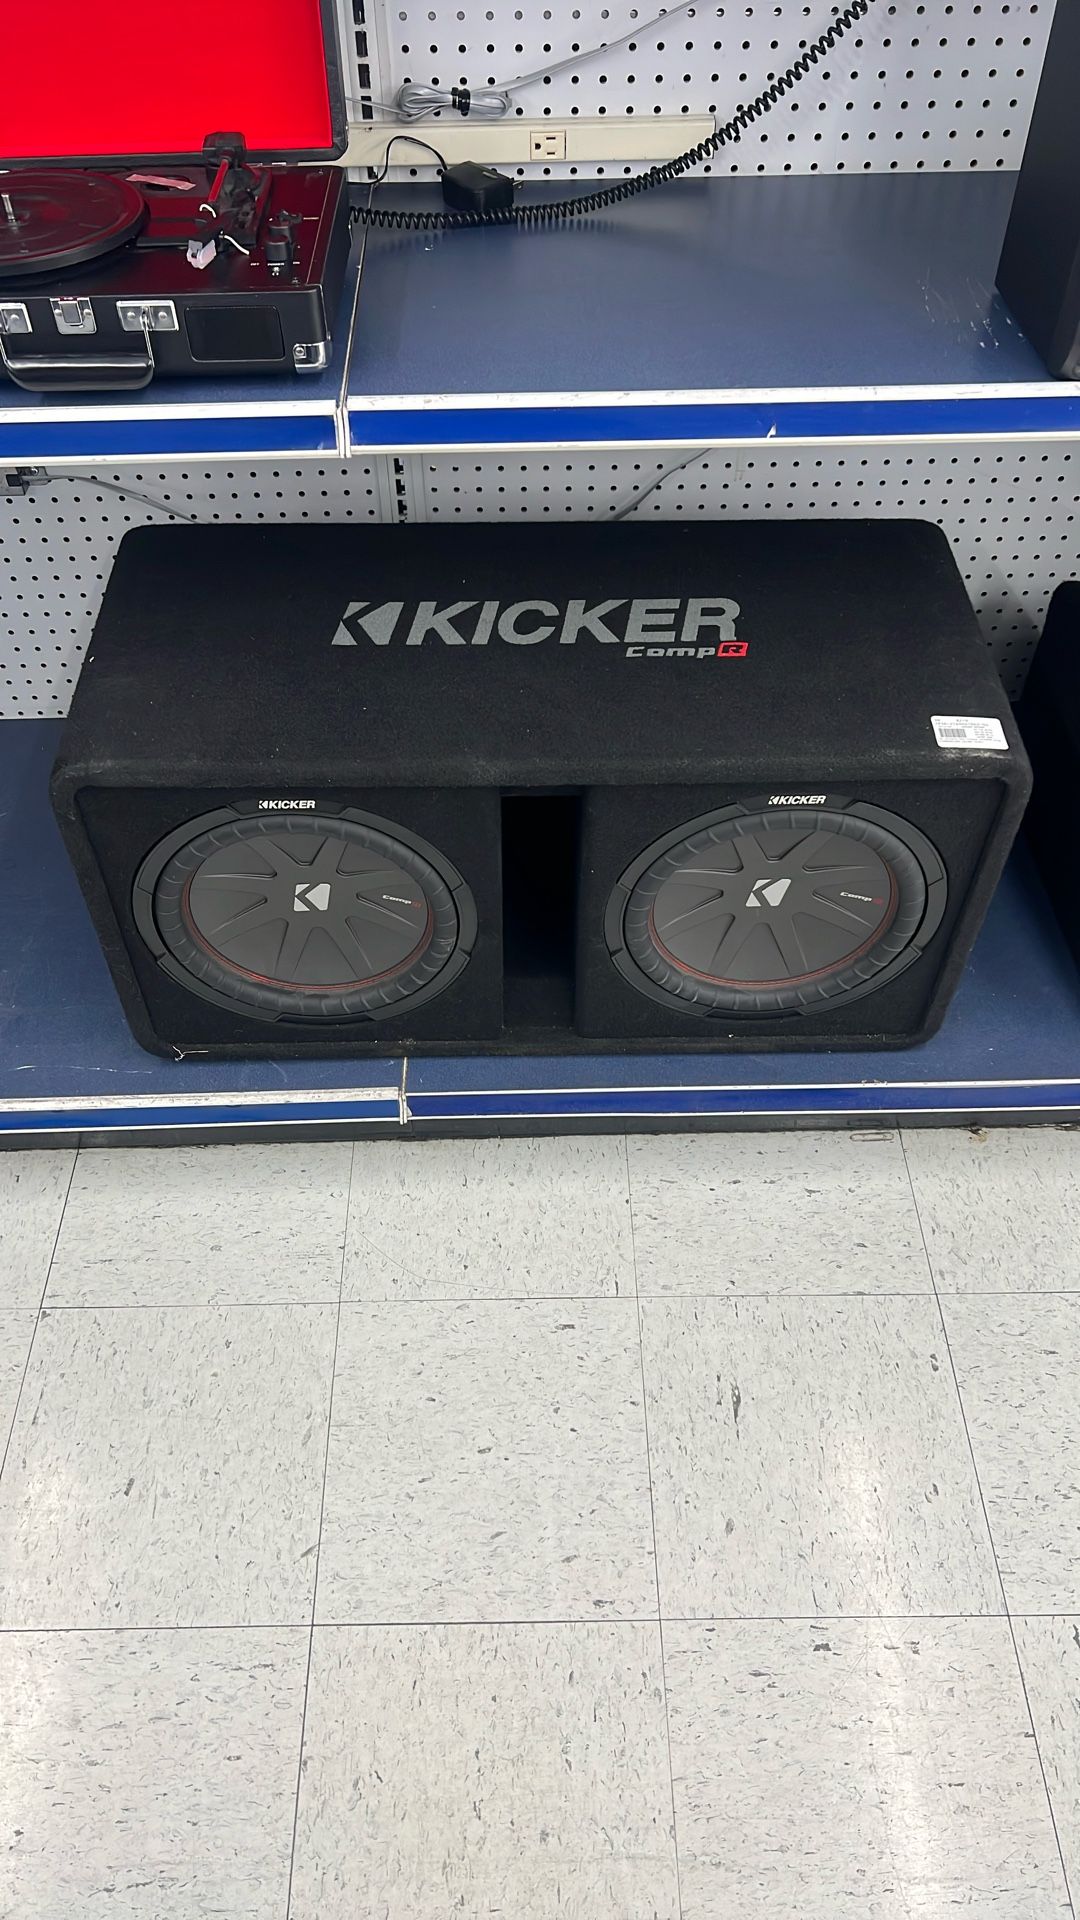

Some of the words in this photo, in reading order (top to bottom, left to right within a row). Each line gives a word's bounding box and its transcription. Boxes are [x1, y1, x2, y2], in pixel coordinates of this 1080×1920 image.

[405, 597, 742, 646] KICKER
[268, 800, 316, 809] KICKER
[777, 795, 827, 805] KICKER
